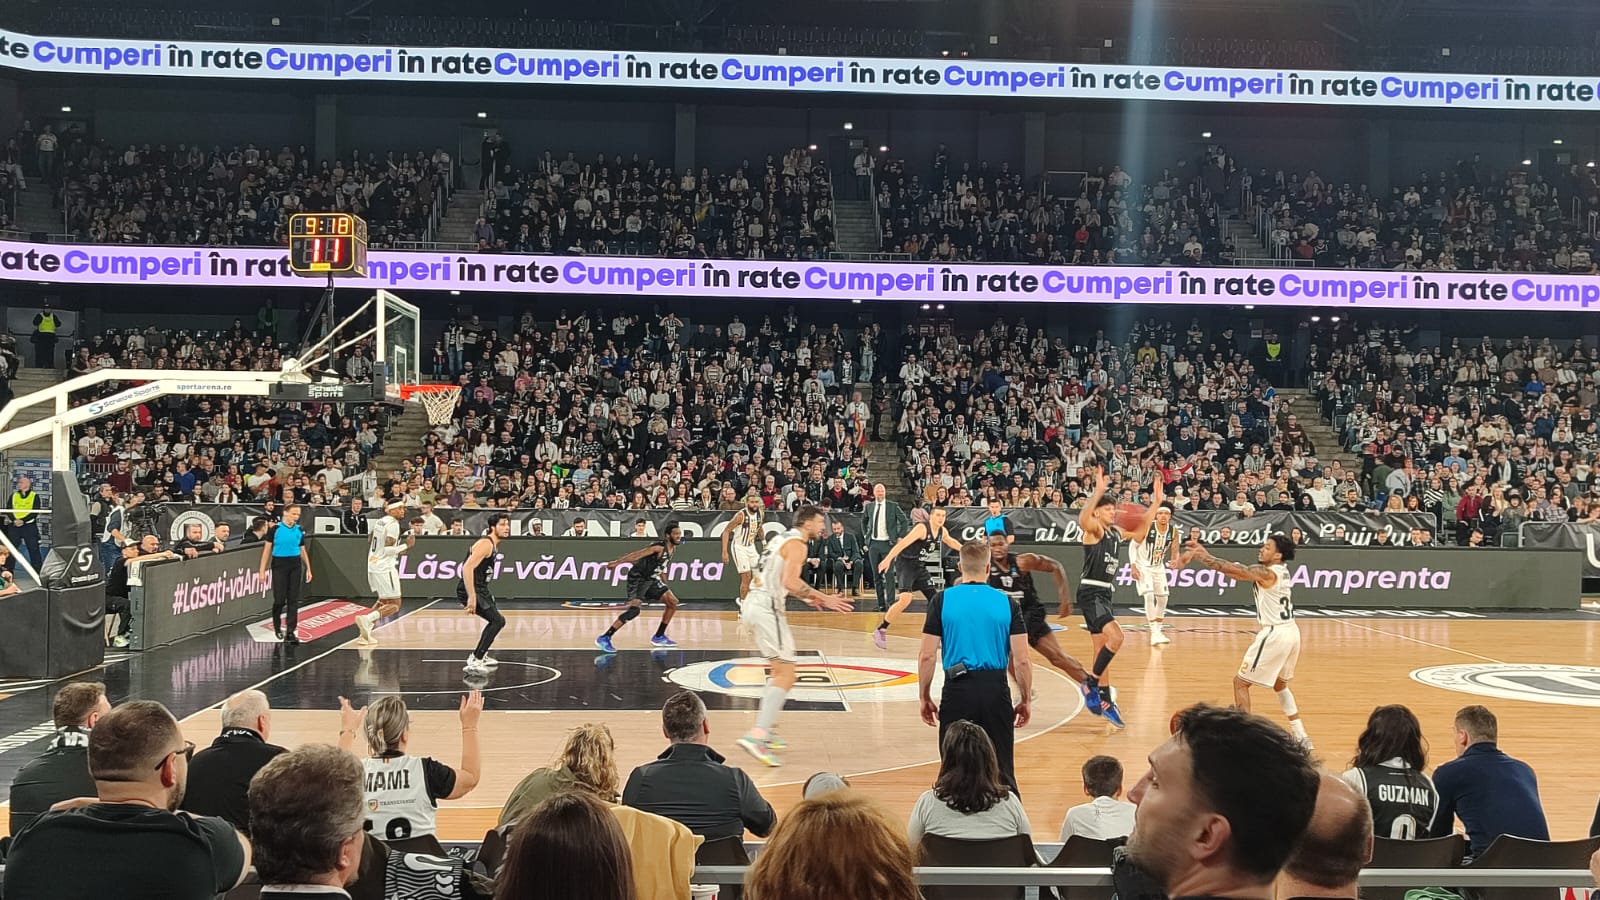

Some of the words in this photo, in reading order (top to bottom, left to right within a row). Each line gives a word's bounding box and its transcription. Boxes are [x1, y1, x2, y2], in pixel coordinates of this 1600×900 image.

[34, 41, 161, 70] Cumperi
[167, 44, 193, 67] în
[201, 48, 262, 69] rate
[266, 48, 391, 76] Cumperi
[398, 49, 424, 73] în
[432, 53, 492, 75] rate
[495, 53, 619, 81] Cumperi
[625, 55, 651, 78] în
[659, 58, 718, 80] rate
[722, 59, 843, 86] Cumperi
[849, 62, 875, 83] în
[883, 65, 940, 85] rate
[944, 66, 1064, 92] Cumperi
[1070, 67, 1096, 88] în
[1104, 71, 1160, 90] rate
[1164, 71, 1282, 98] Cumperi
[1288, 73, 1313, 95] în
[1321, 77, 1377, 97] rate
[1381, 77, 1498, 104] Cumperi
[1504, 78, 1530, 100] în
[1537, 80, 1594, 101] rate
[306, 218, 348, 234] 9:18
[314, 238, 340, 262] 11
[0, 249, 60, 272] ate
[64, 250, 200, 279] Cumperi
[208, 252, 237, 276] în
[246, 255, 291, 277] rat
[367, 257, 450, 285] mperi
[457, 257, 485, 281] în
[494, 261, 558, 283] rate
[563, 262, 695, 291] Cumperi
[702, 263, 729, 287] în
[738, 267, 800, 289] rate
[805, 267, 934, 297] Cumperi
[940, 268, 968, 291] în
[977, 271, 1038, 292] rate
[1043, 271, 1171, 299] Cumperi
[1179, 271, 1205, 294] în
[1214, 275, 1275, 296] rate
[1280, 275, 1406, 303] Cumperi
[1413, 276, 1439, 299] în
[1448, 280, 1507, 300] rate
[1378, 783, 1429, 807] GUZMAN
